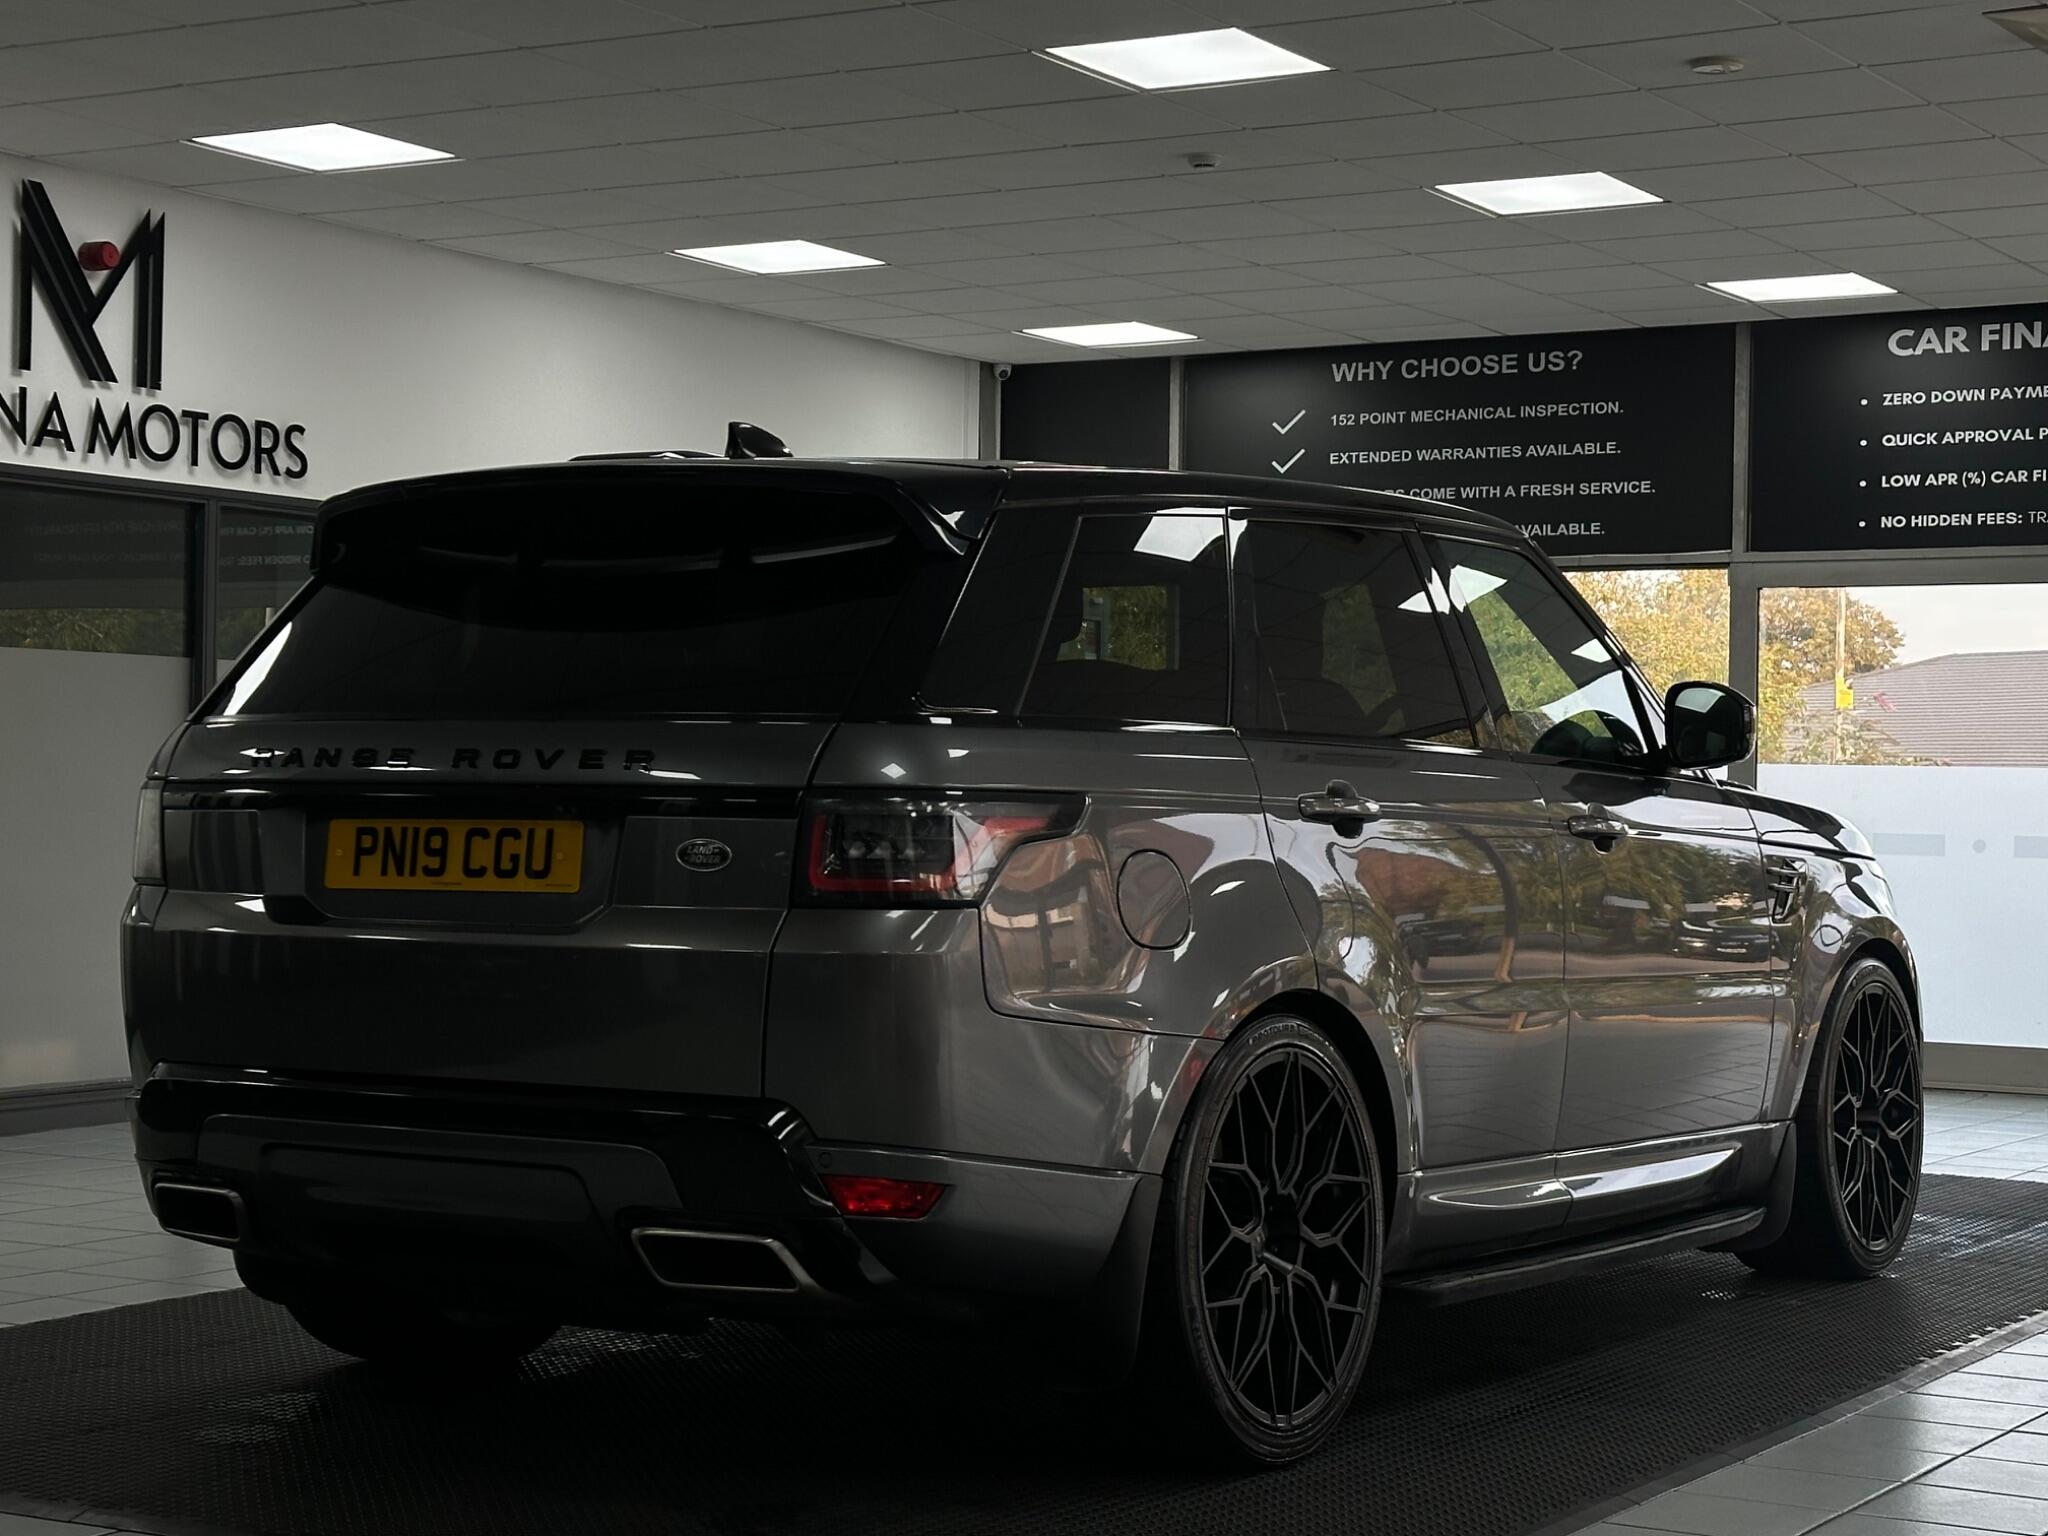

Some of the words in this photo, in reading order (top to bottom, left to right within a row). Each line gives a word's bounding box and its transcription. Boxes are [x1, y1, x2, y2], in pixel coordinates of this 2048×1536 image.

[1887, 325, 1970, 357] CAR
[1980, 320, 2048, 352] FIN
[1332, 359, 1394, 383] WHY
[1400, 352, 1519, 380] CHOOSE
[1527, 350, 1583, 373] US?
[1882, 391, 1927, 407] ZERO
[1930, 388, 1986, 404] DOWN
[1330, 413, 1356, 427] 152
[1359, 410, 1407, 426] POINT
[1410, 405, 1517, 424] MECHANICAL
[1520, 400, 1624, 419] INSPECTION.
[88, 397, 309, 480] MOTORS
[1881, 432, 1939, 448] QUICK
[1942, 427, 2035, 446] APPROVAL
[1329, 449, 1413, 466] EXTENDED
[1416, 444, 1523, 463] WARRANTIES
[1525, 440, 1622, 458] AVAILABLE.
[1409, 486, 1457, 501] COME
[1461, 484, 1501, 499] WITH
[1504, 482, 1516, 497] A
[1519, 480, 1576, 498] FRESH
[1578, 477, 1657, 496] SERVICE.
[1881, 473, 1921, 488] LOW
[1925, 472, 1958, 486] APR
[1962, 471, 1986, 488] (%)
[1990, 469, 2028, 484] CAR
[1880, 515, 1907, 529] NO
[1910, 512, 1973, 527] HIDDEN
[1977, 511, 2023, 526] FEES:
[452, 748, 656, 769] ROVER
[352, 826, 449, 878] PN19
[462, 827, 554, 880] CGU
